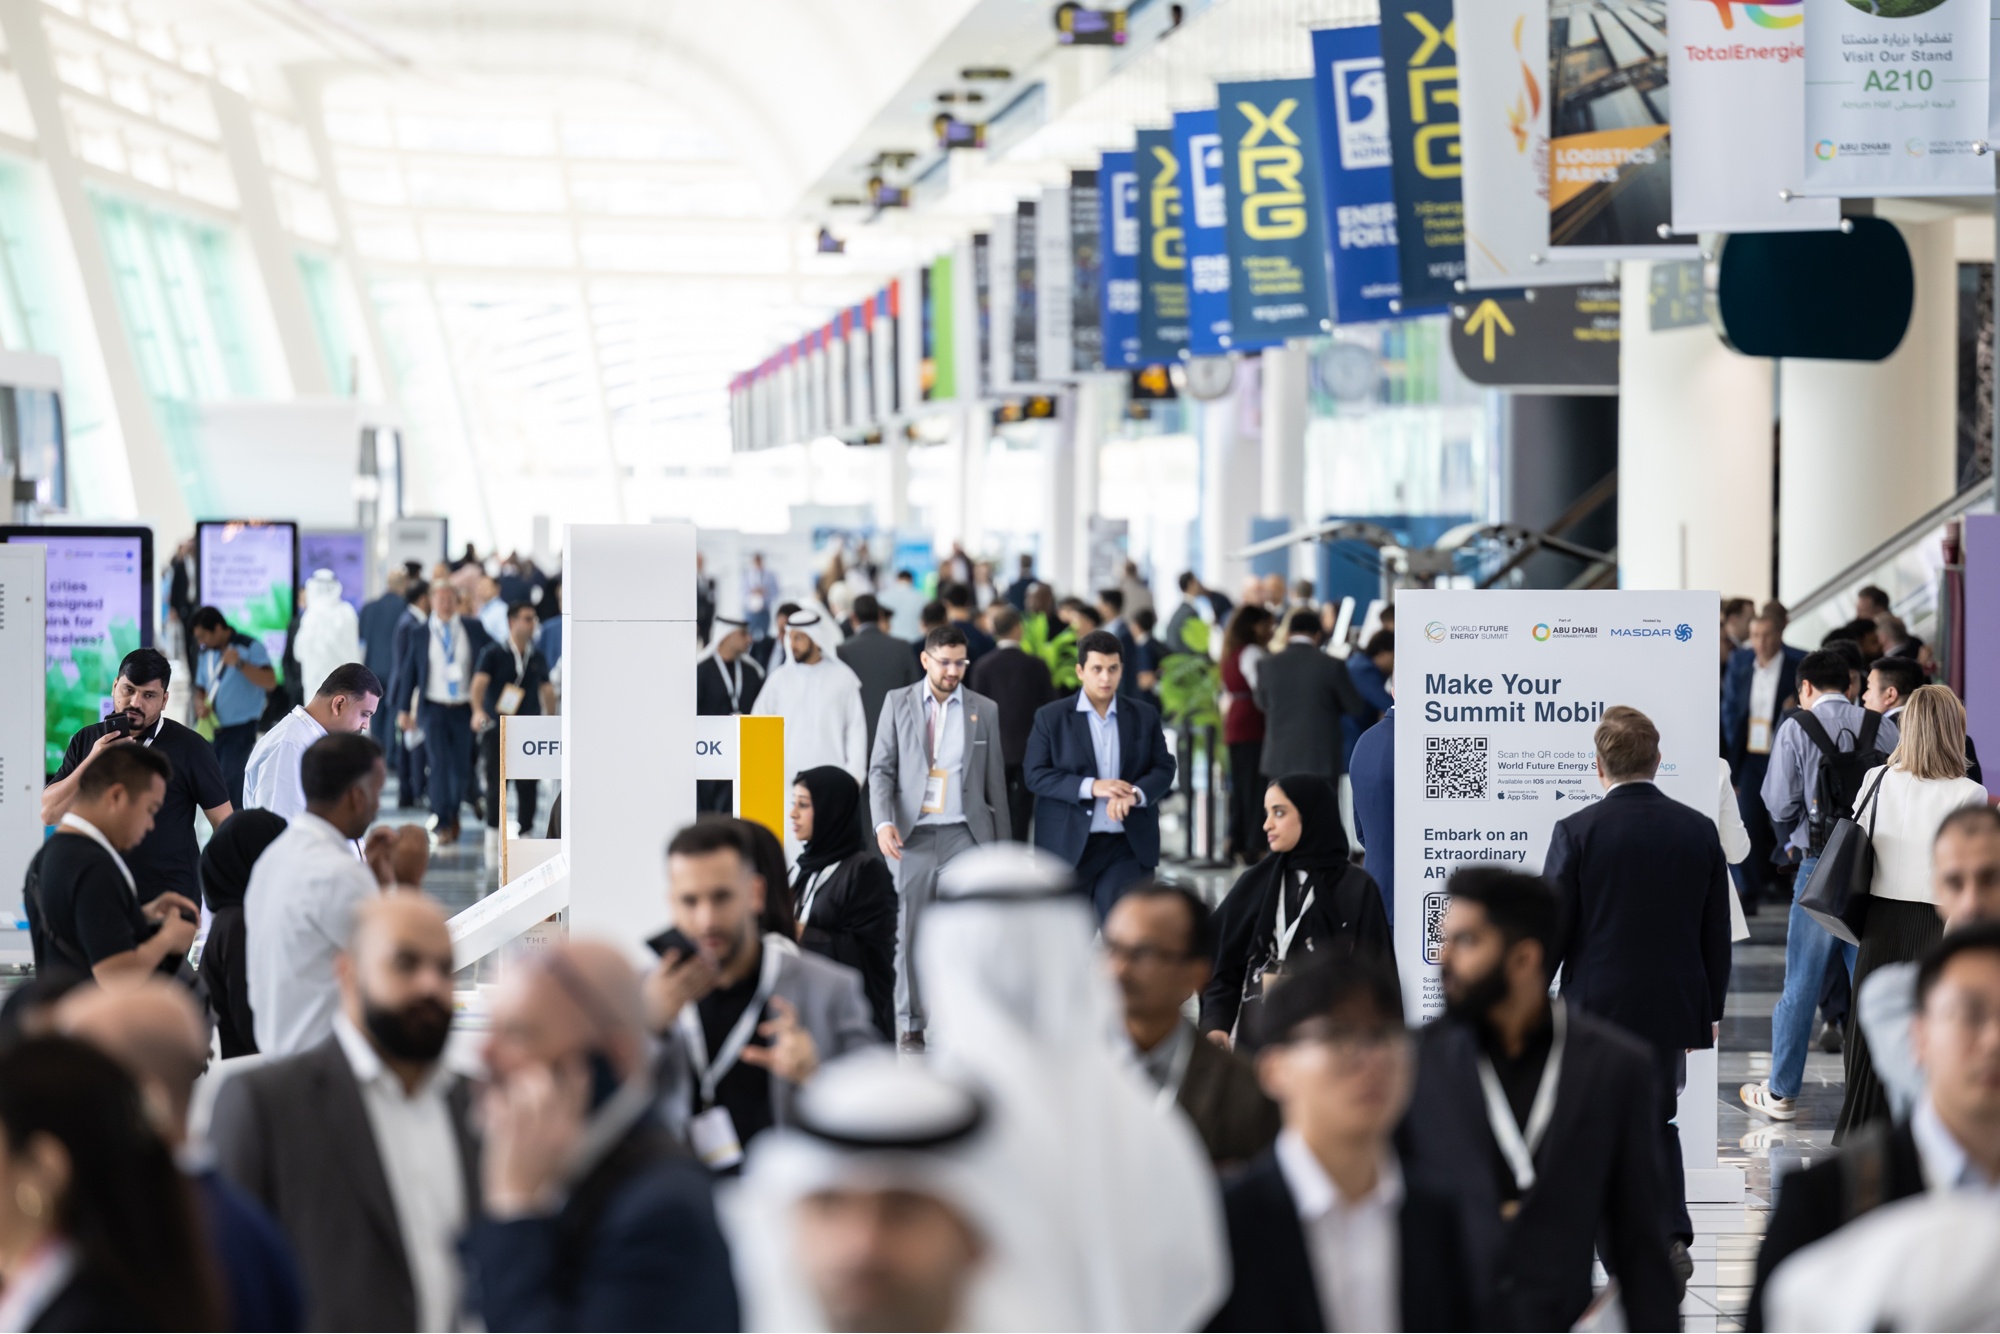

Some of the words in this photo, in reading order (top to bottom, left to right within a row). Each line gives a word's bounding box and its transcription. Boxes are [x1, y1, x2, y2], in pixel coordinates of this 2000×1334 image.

[1685, 42, 1804, 62] TotalEnergie
[1843, 51, 1874, 62] Visit
[1880, 50, 1905, 62] Our
[1911, 49, 1953, 62] Stand
[1864, 69, 1933, 92] A210
[1556, 148, 1656, 164] LOGISTICS
[1236, 98, 1307, 241] XRG
[1556, 166, 1619, 182] PARKS
[46, 599, 103, 611] esigned
[46, 616, 69, 626] ink
[1610, 628, 1671, 637] MASDAR
[1425, 673, 1493, 695] Make
[1501, 673, 1562, 695] Your
[1425, 700, 1525, 722] Summit
[1535, 701, 1604, 722] Mobil
[1498, 750, 1519, 759] Scan
[1522, 750, 1535, 759] the
[1537, 750, 1551, 759] QR
[1554, 750, 1575, 759] code
[1577, 750, 1585, 759] to
[1498, 762, 1523, 770] World
[1526, 762, 1555, 770] Future
[1558, 762, 1588, 771] Energy
[1659, 762, 1676, 771] App
[1424, 828, 1481, 841] Embark
[1486, 831, 1505, 841] on
[1510, 831, 1528, 841] an
[1424, 847, 1526, 863] Extraordinary
[1424, 866, 1446, 878] AR
